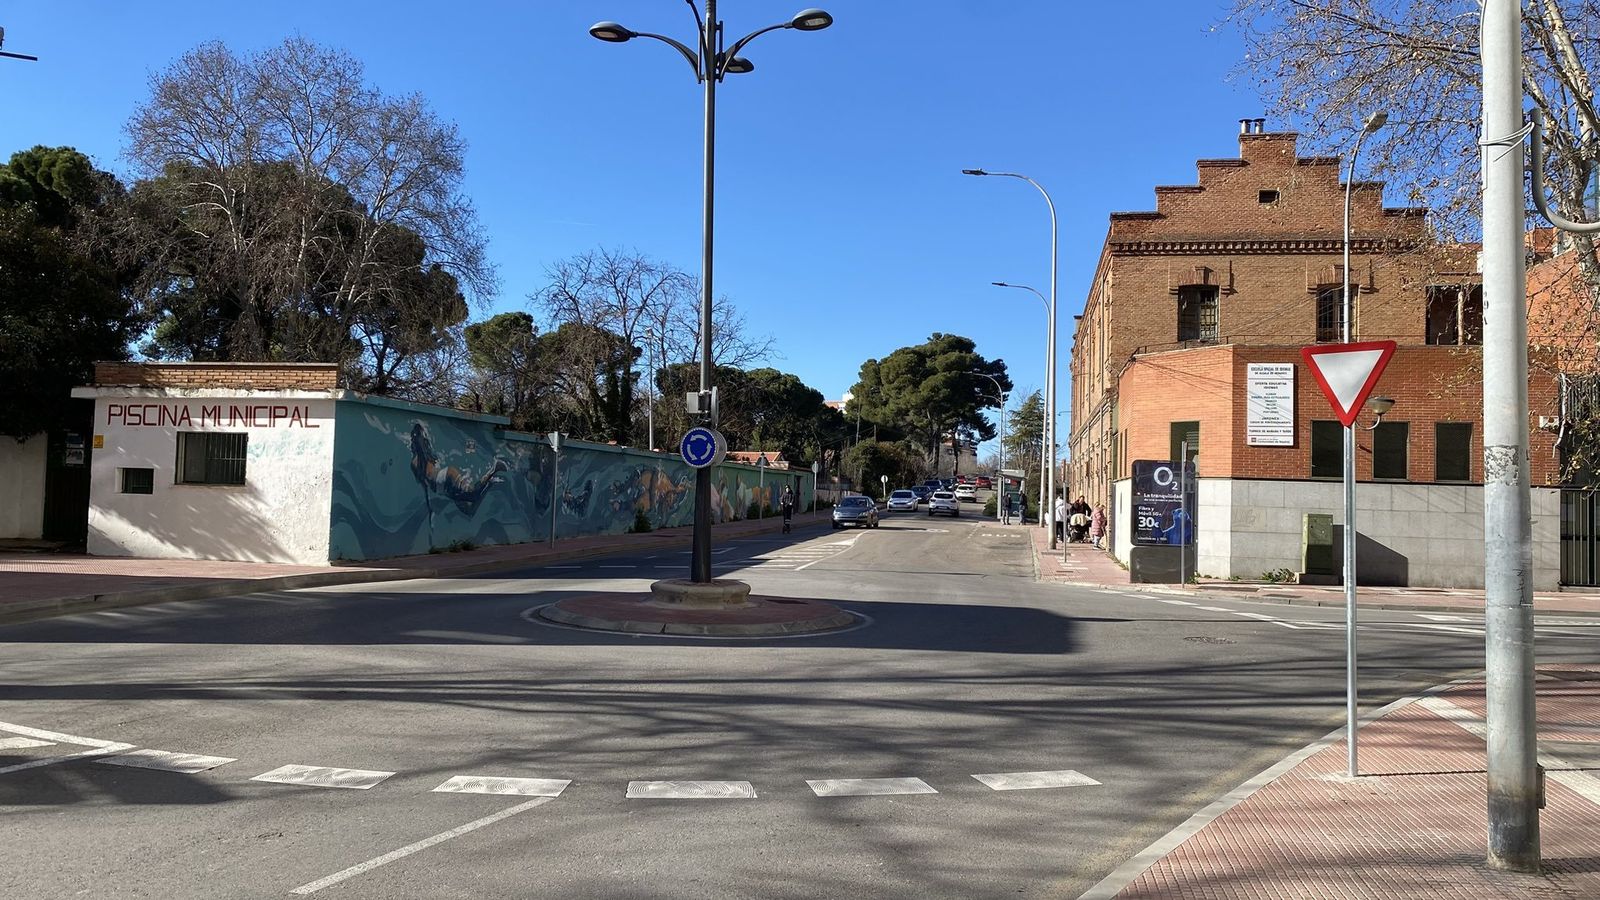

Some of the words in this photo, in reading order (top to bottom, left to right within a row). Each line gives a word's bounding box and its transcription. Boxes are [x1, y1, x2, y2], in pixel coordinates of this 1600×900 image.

[108, 404, 192, 427] PISCINA
[201, 405, 320, 428] MUNICIPAL
[1138, 516, 1160, 528] 30€
